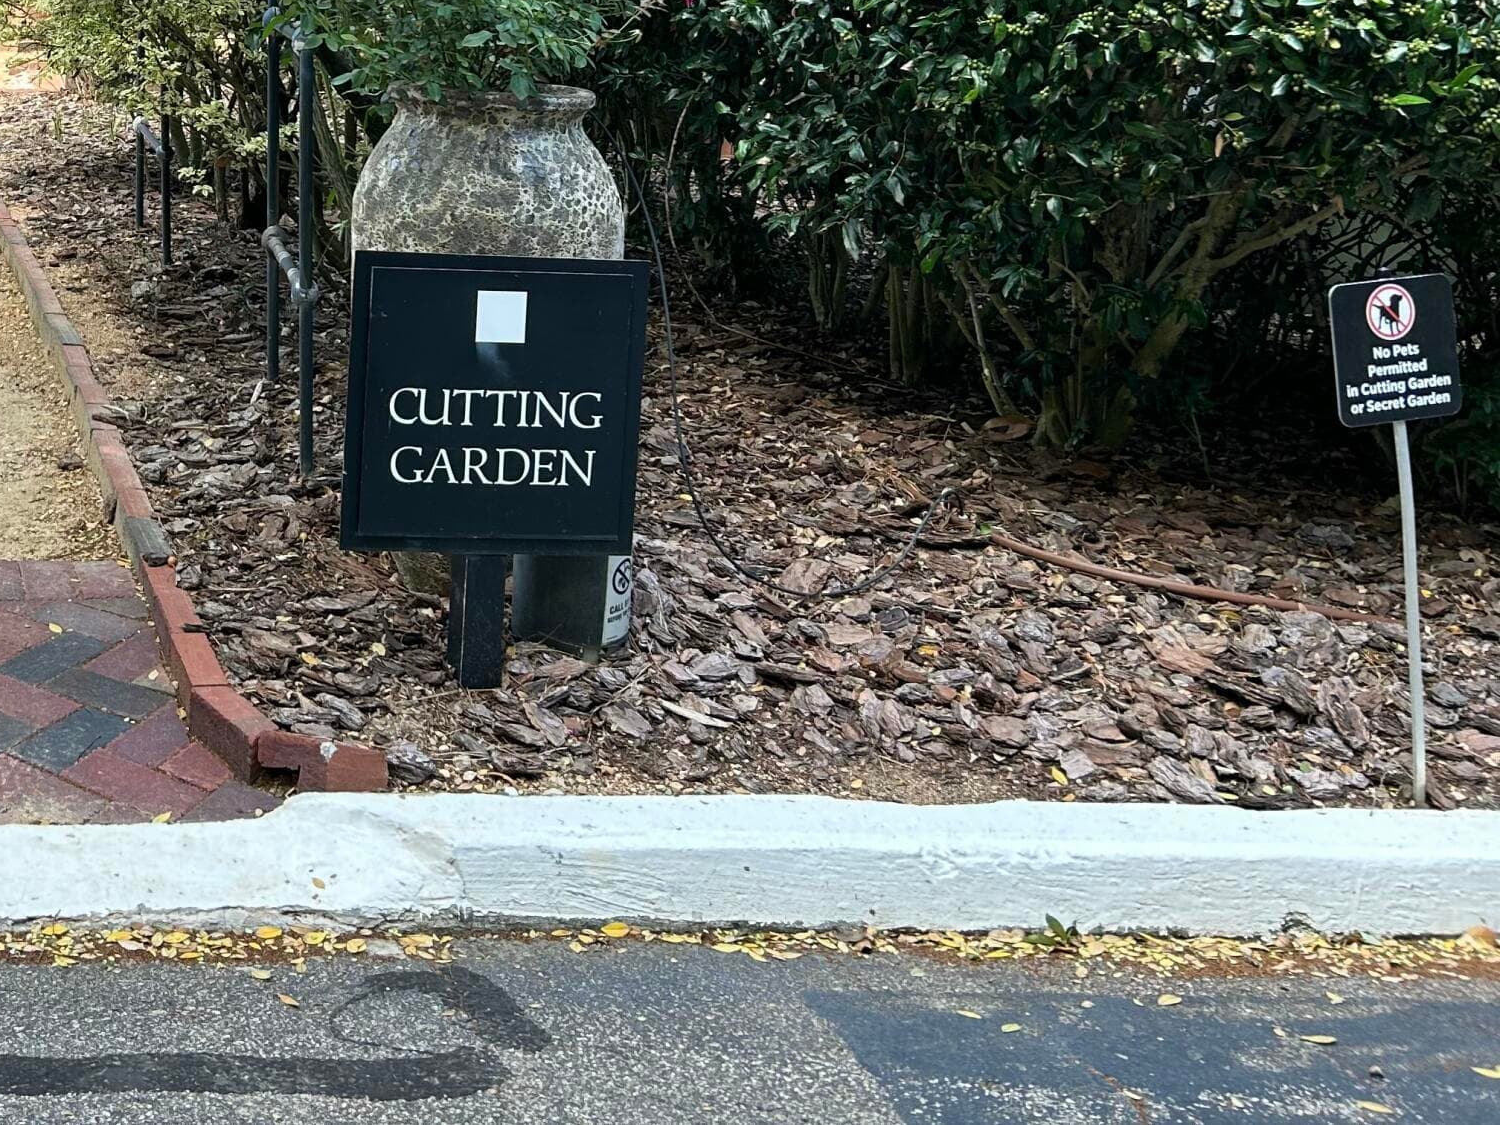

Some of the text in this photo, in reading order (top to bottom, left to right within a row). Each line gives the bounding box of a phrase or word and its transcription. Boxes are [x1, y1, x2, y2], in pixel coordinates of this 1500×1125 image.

[1372, 343, 1420, 359] No Pets
[1368, 358, 1428, 377] Permitted
[1347, 375, 1451, 398] in Cutting Garden
[389, 387, 603, 429] CUTTING
[1351, 392, 1450, 414] or Secret Garden
[390, 445, 597, 486] GARDEN
